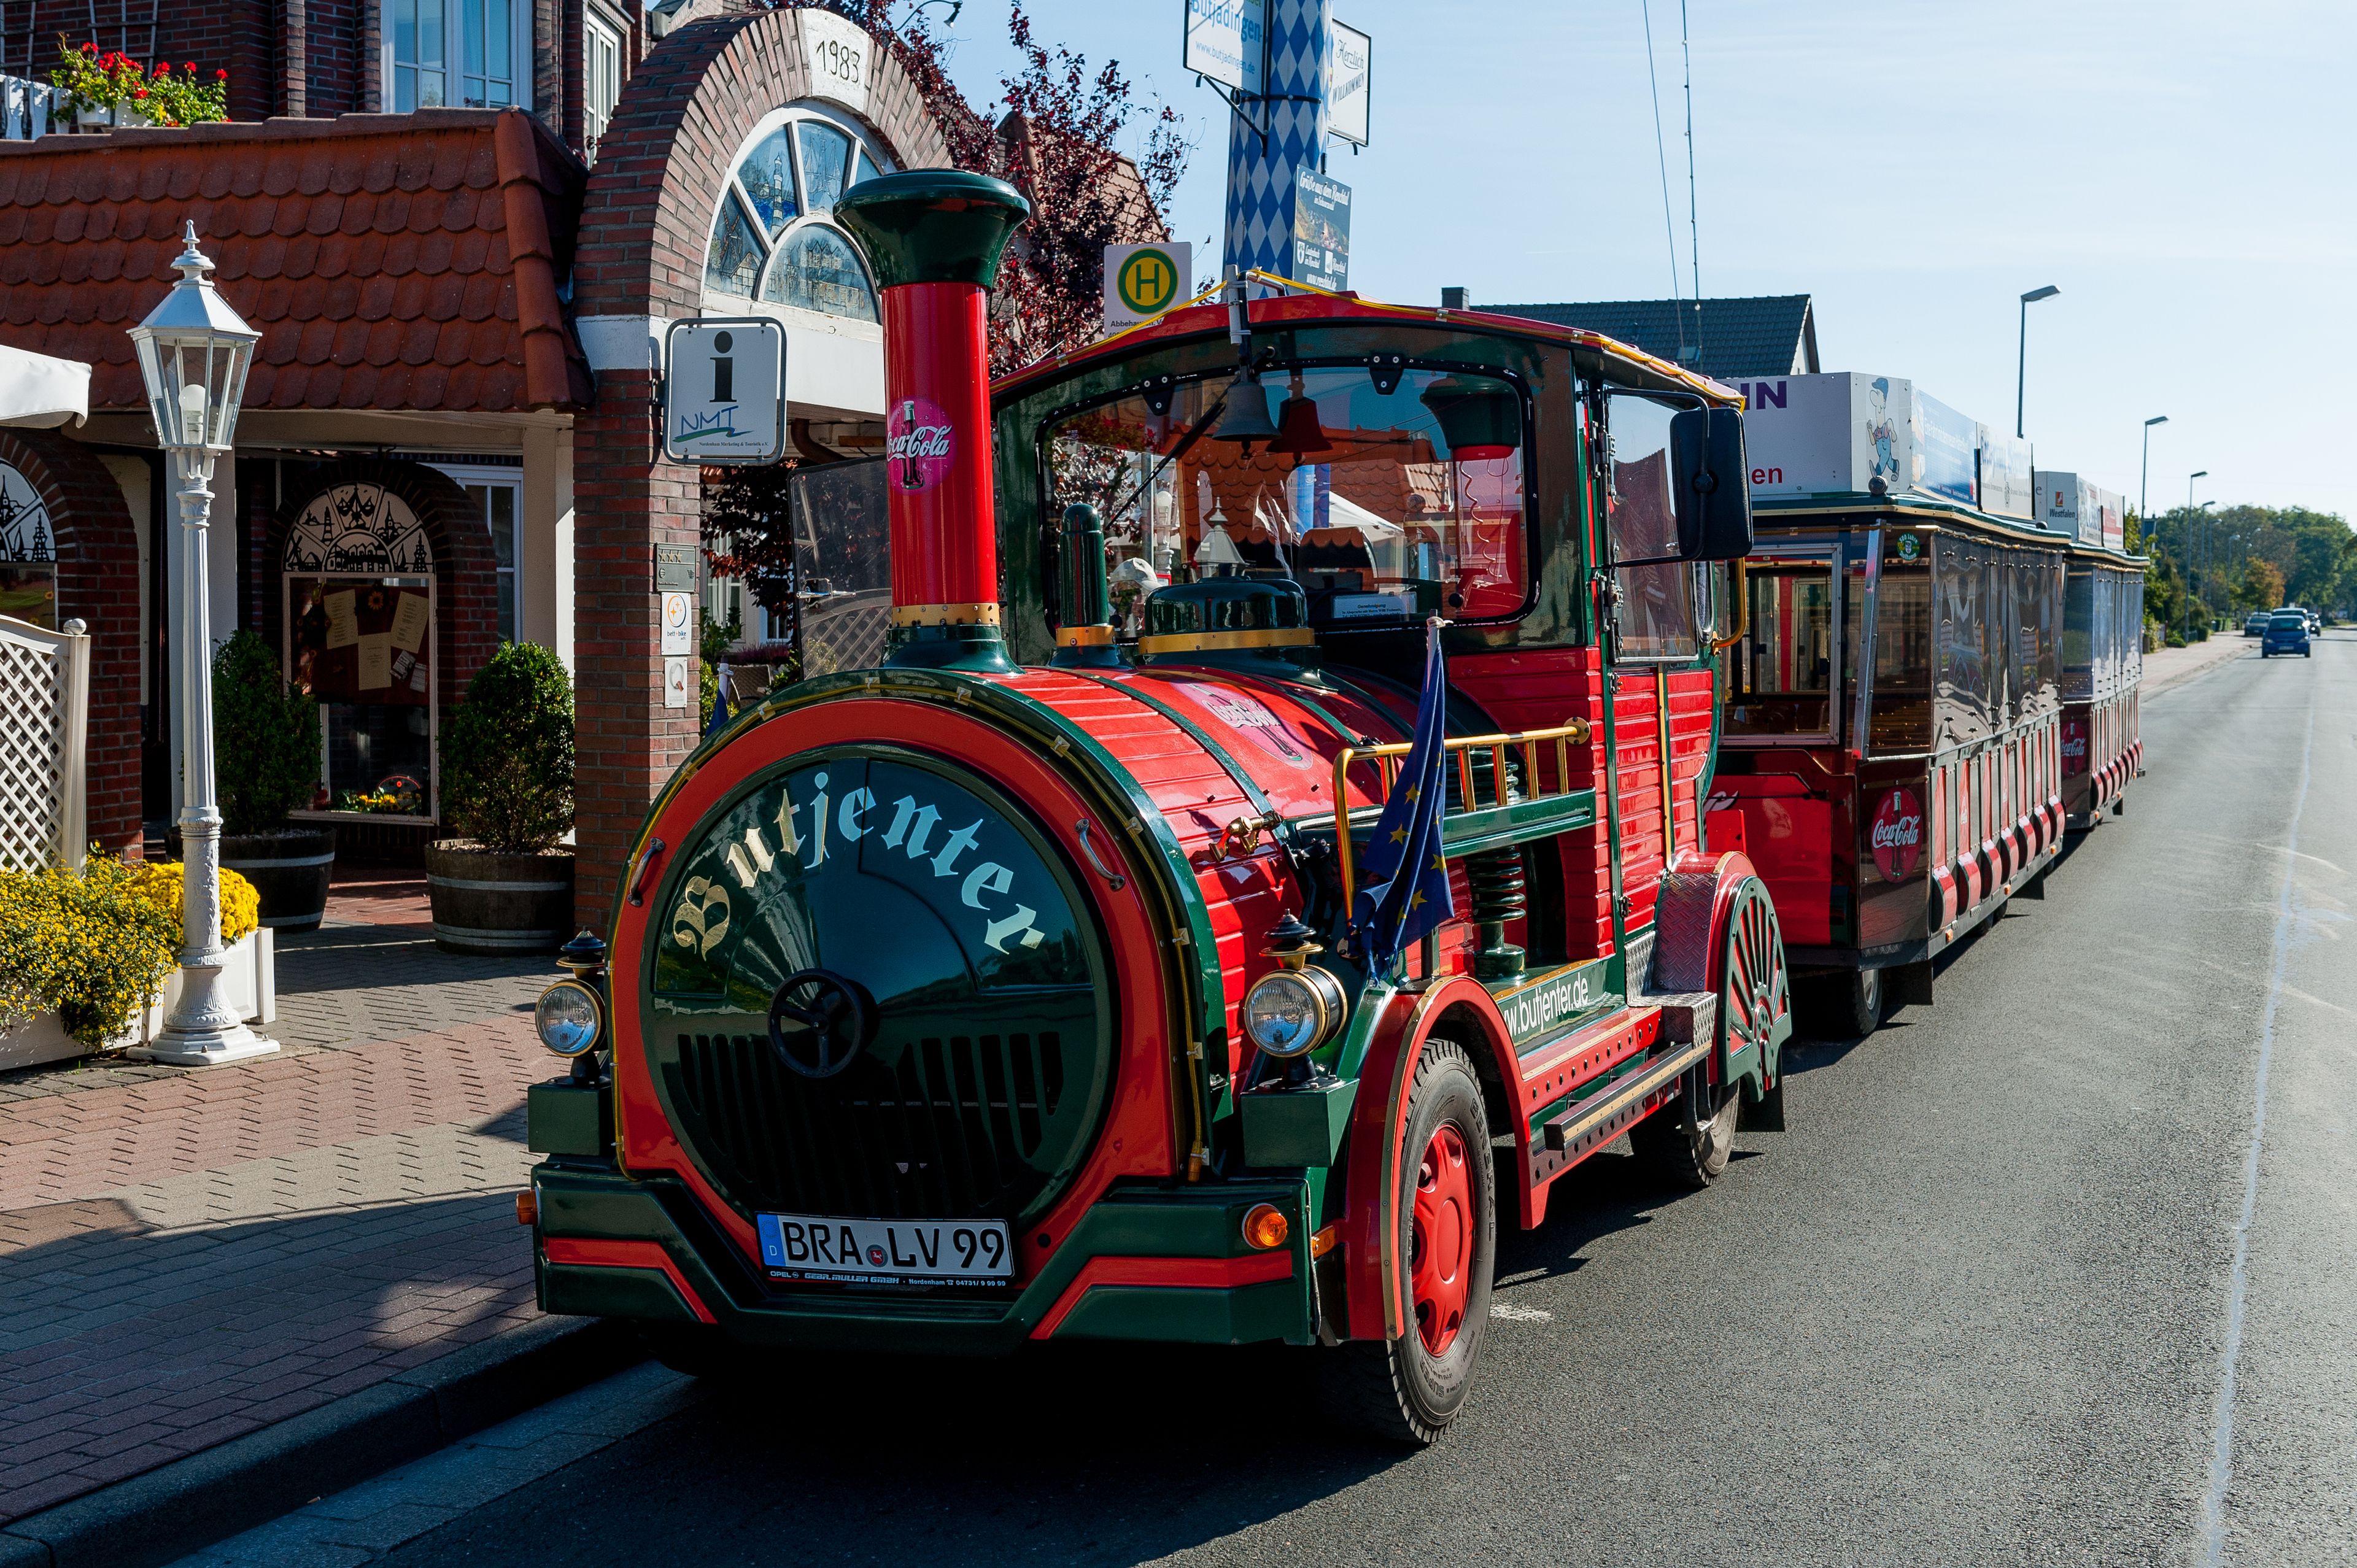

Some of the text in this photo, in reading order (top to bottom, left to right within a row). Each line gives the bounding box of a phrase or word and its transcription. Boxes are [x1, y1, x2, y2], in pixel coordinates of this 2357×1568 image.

[816, 40, 860, 83] 1983
[1196, 41, 1255, 74] www.butjadingen.de
[1336, 39, 1364, 69] Herzlich
[1332, 71, 1365, 106] WILLKOMMEN
[1300, 171, 1316, 191] Grüße
[1136, 263, 1159, 300] H
[710, 330, 737, 403] i
[681, 405, 738, 435] NMT
[887, 425, 952, 462] Coca-Cola
[2049, 508, 2075, 518] Westfalen
[1872, 815, 1921, 848] Coca-Cola
[674, 772, 1045, 961] Butjenter
[1470, 1097, 1495, 1241] GENERAL
[770, 1245, 777, 1256] D
[782, 1221, 1005, 1269] BRA LV 99
[1420, 1359, 1444, 1398] SUPER
